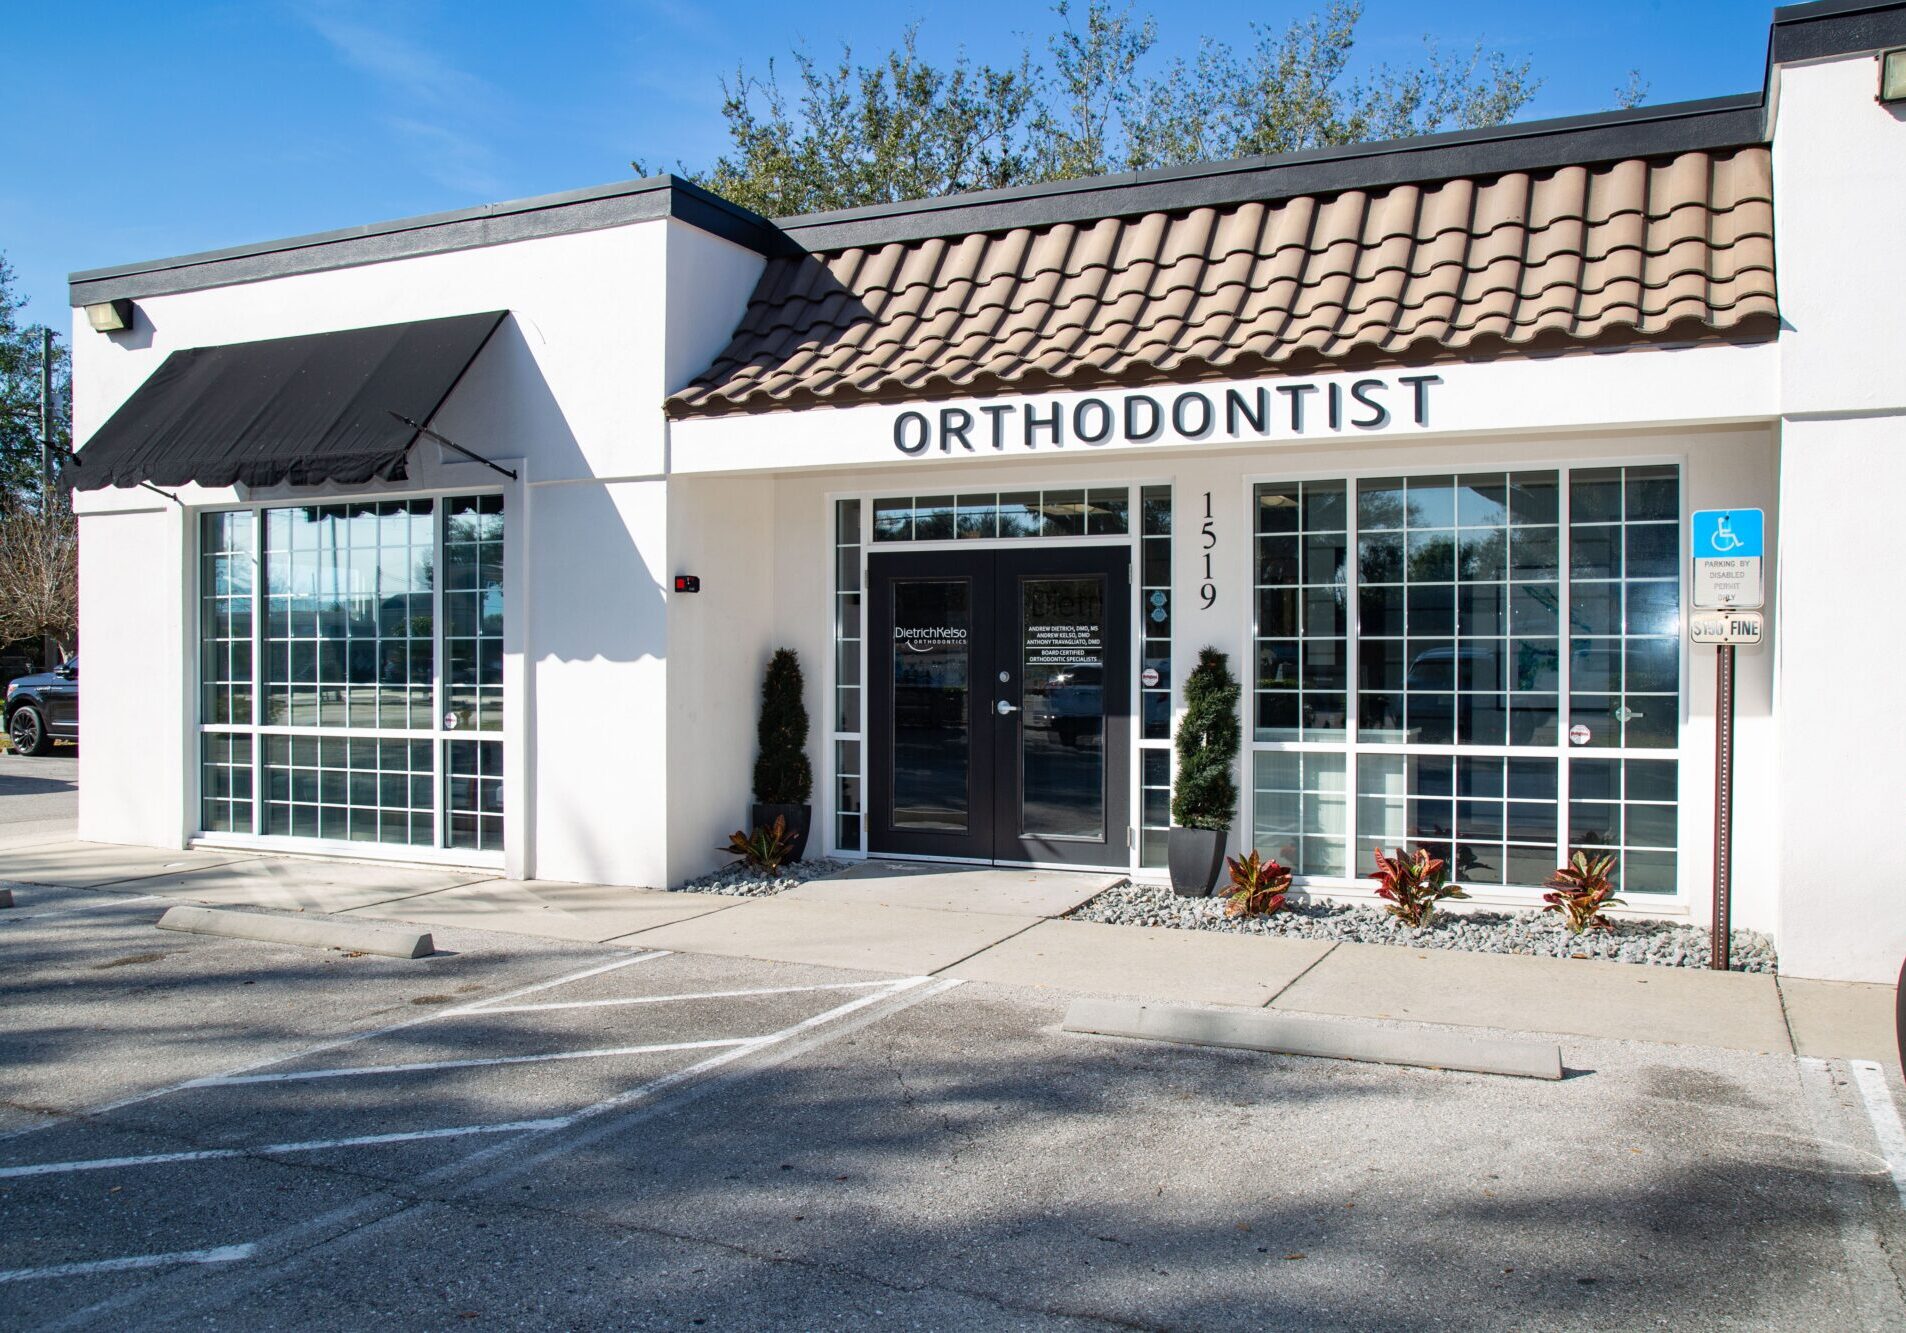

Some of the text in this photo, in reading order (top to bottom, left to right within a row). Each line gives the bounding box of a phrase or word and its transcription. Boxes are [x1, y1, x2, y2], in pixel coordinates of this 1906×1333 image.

[893, 374, 1440, 454] ORTHODONTIST
[1200, 491, 1217, 611] 1519
[1704, 560, 1736, 568] PARKING
[1709, 571, 1745, 579] DISABLED
[1713, 582, 1741, 590] PERMIT
[895, 627, 967, 638] DietrichKelso
[1730, 620, 1759, 636] FINE
